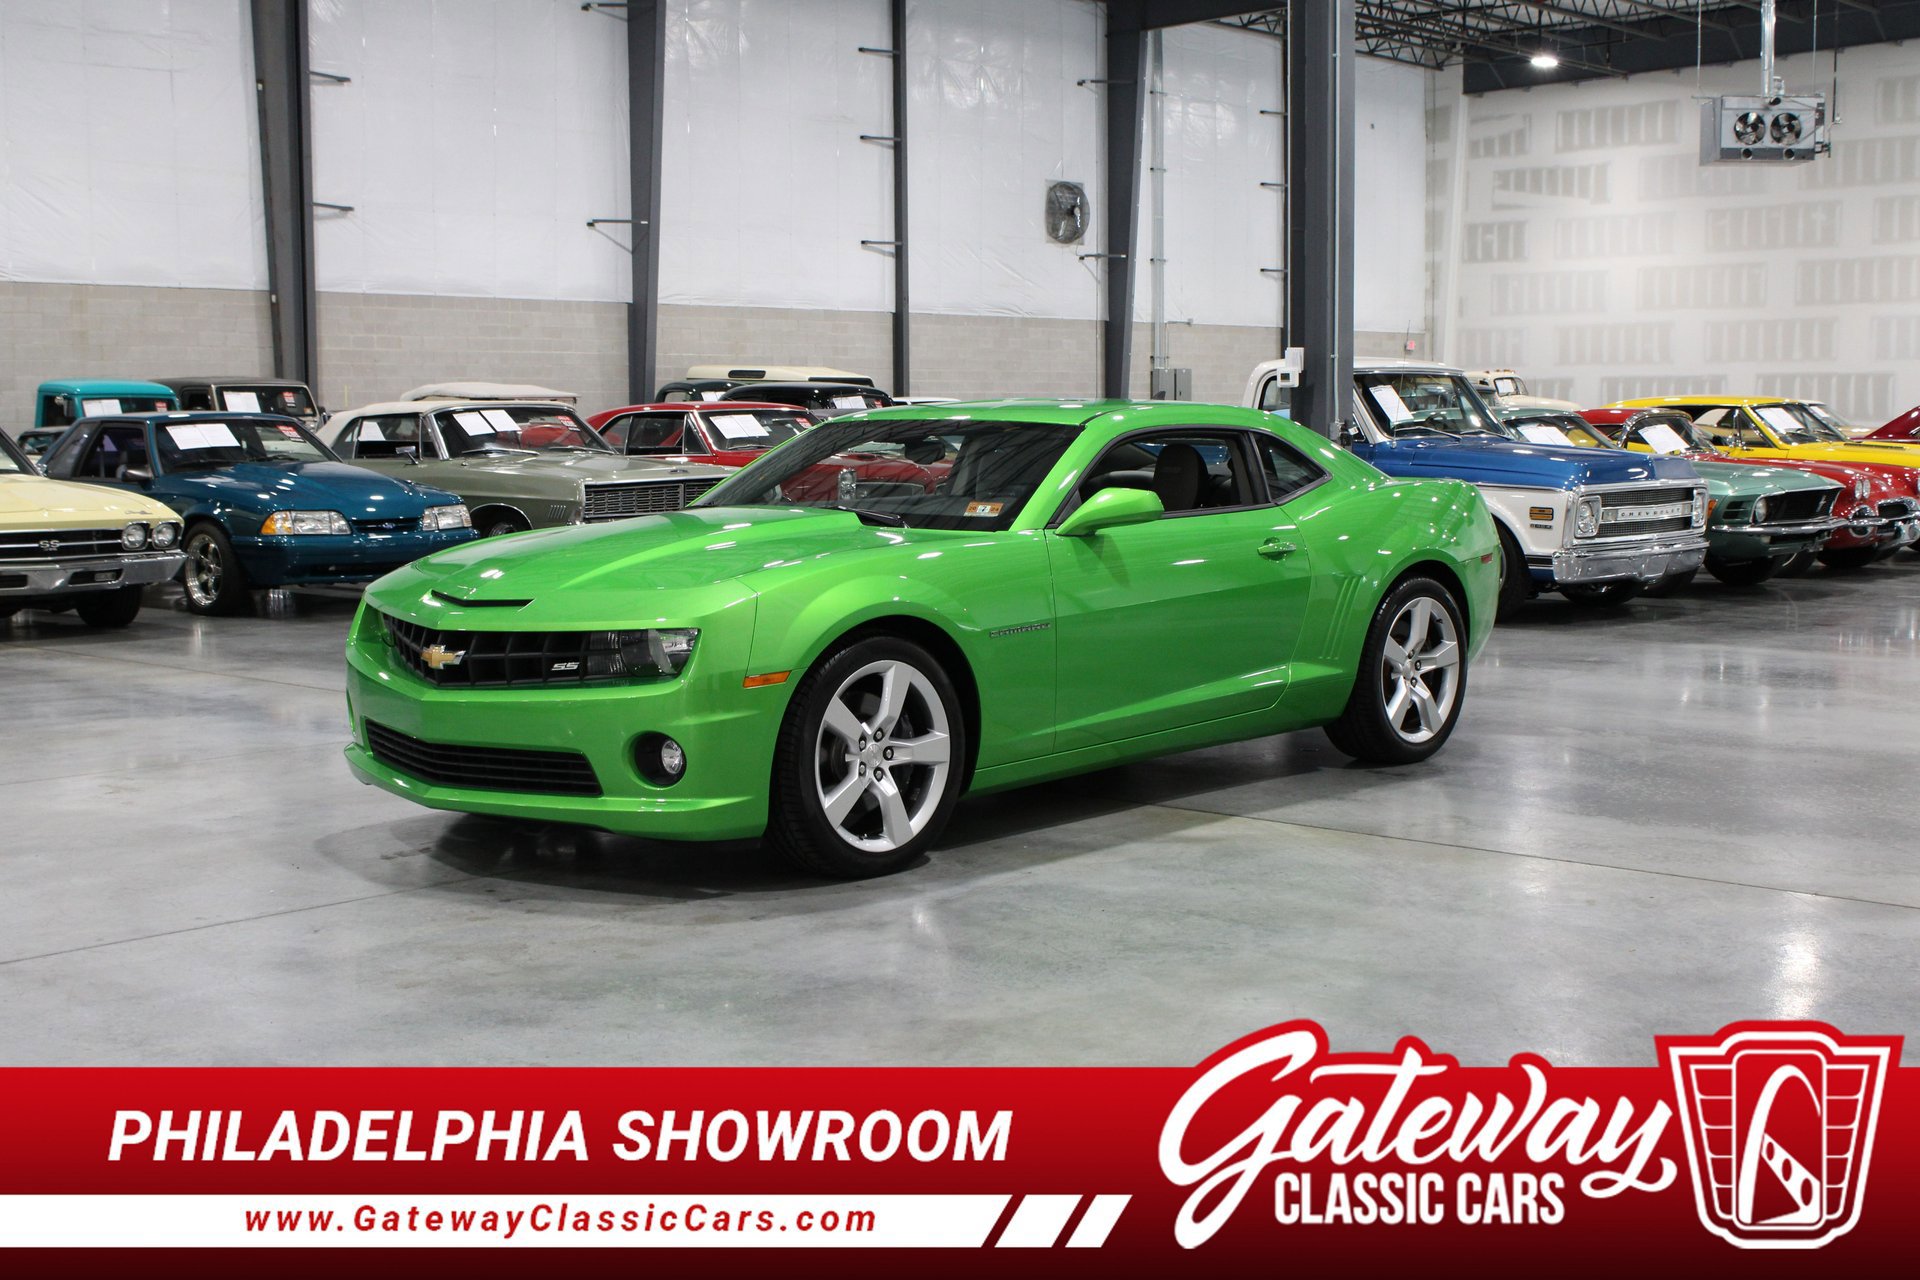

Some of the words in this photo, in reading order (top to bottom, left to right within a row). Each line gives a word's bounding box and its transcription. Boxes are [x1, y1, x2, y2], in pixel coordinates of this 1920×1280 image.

[1620, 507, 1681, 517] CHEVROLET
[39, 539, 60, 548] SS
[551, 662, 580, 671] SS
